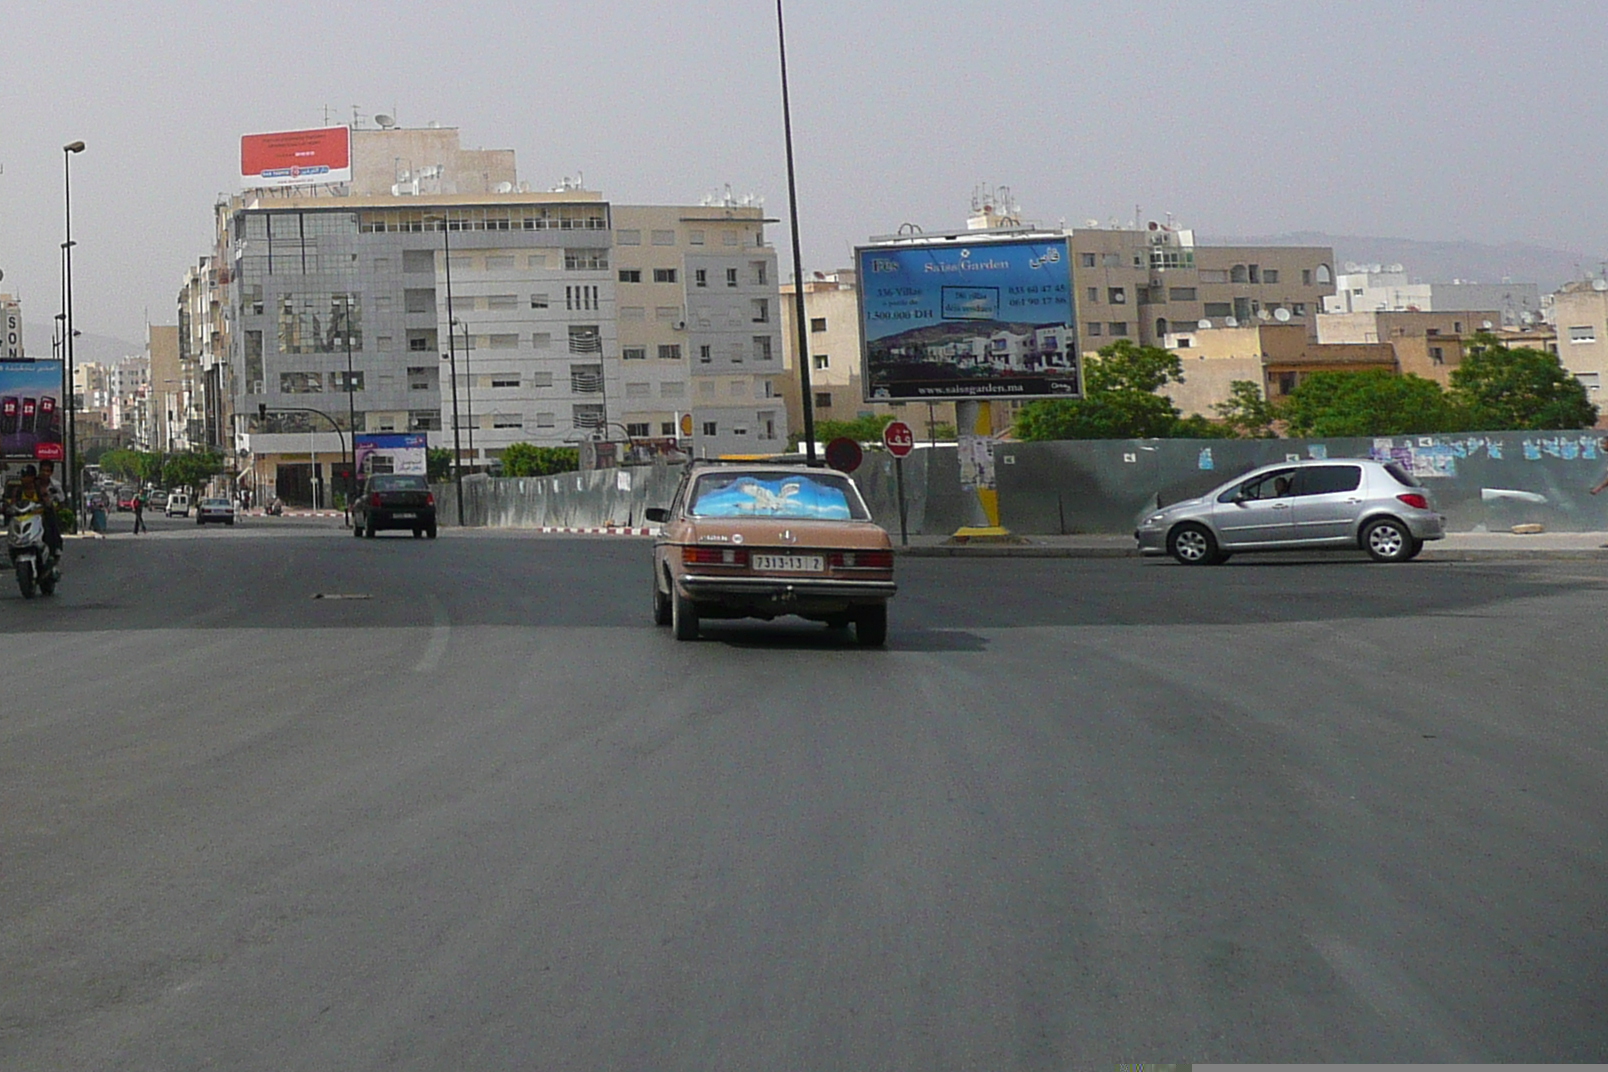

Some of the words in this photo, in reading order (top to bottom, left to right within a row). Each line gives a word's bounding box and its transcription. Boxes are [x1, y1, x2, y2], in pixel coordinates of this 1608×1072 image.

[960, 258, 1010, 272] Garden
[1042, 296, 1052, 305] 17
[914, 309, 934, 319] DH
[4, 403, 15, 412] 12
[24, 405, 34, 414] 12
[43, 402, 53, 411] 12
[887, 429, 911, 446] قف
[813, 558, 820, 569] 2
